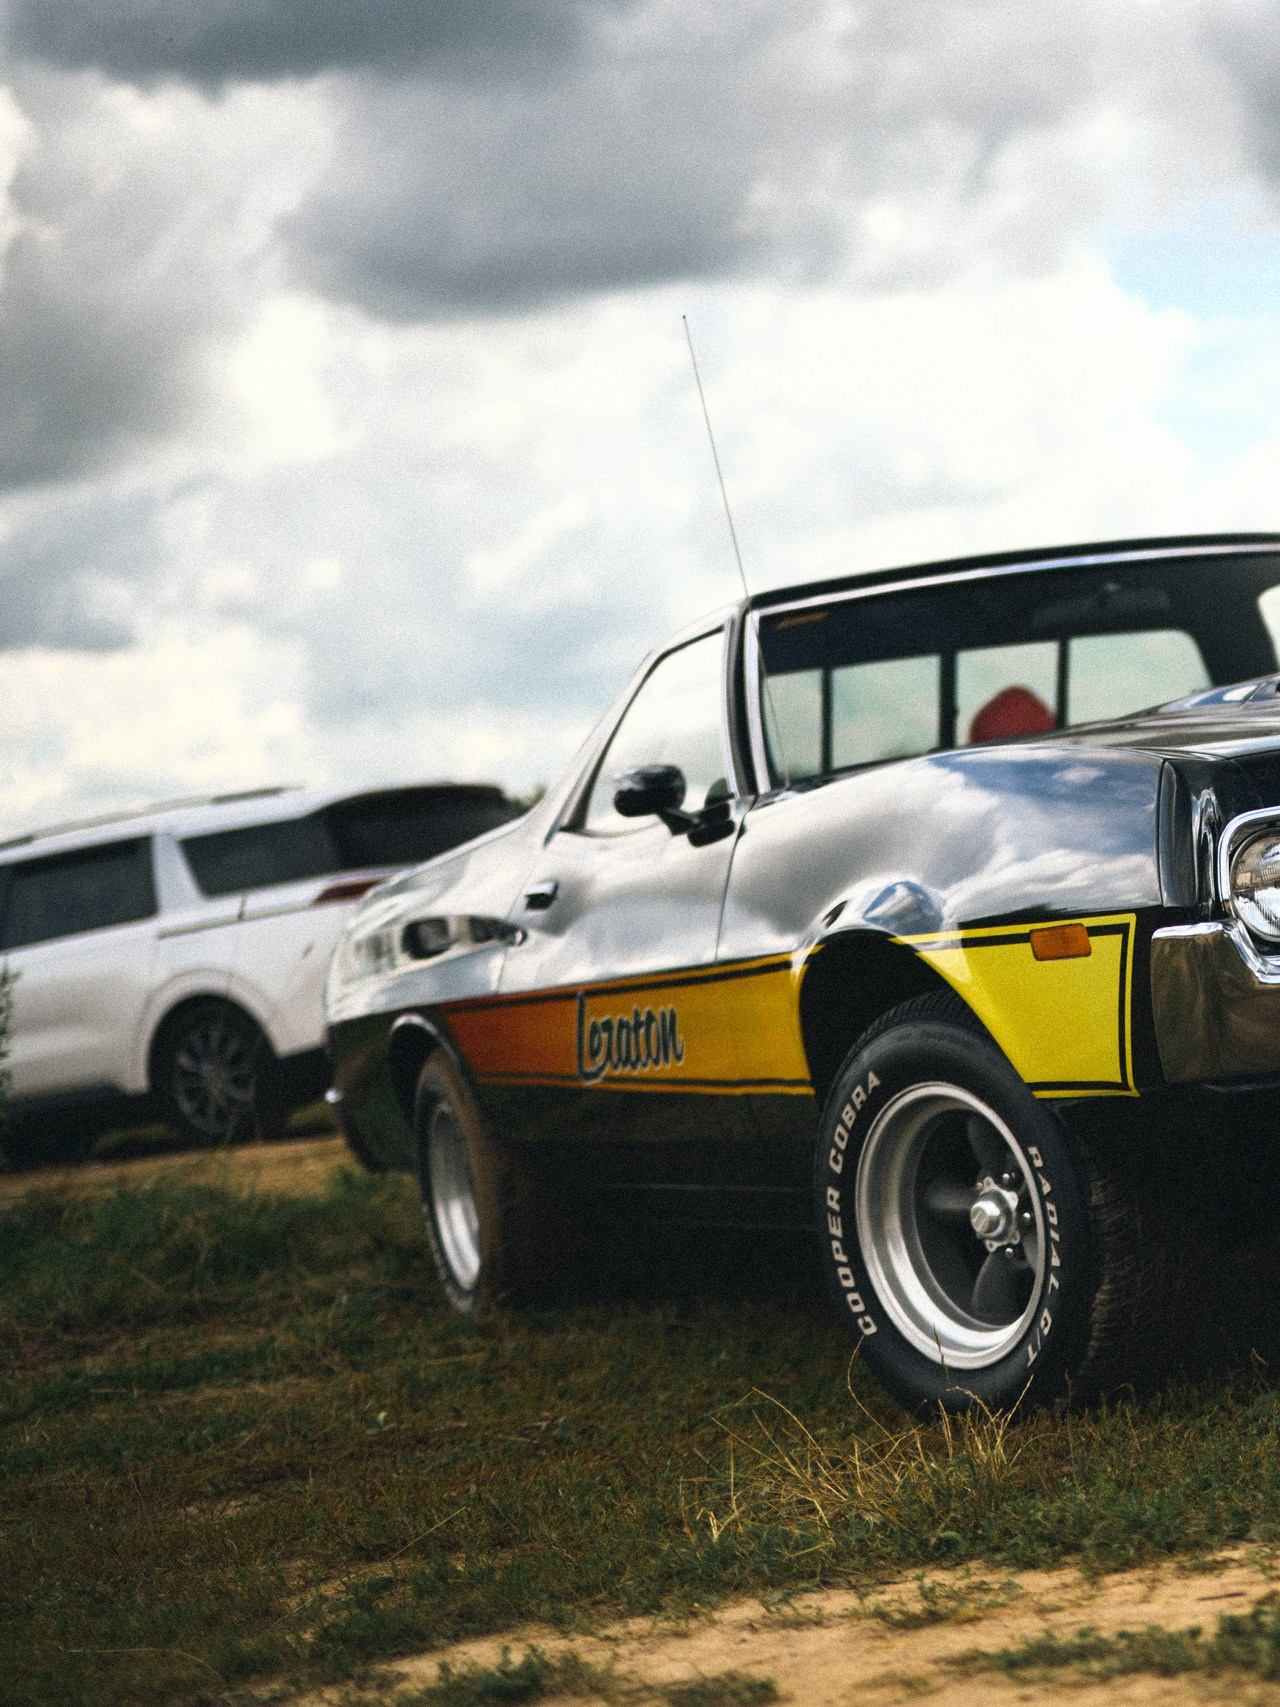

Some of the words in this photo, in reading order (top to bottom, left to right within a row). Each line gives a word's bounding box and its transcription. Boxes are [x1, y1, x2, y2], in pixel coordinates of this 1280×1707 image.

[828, 1070, 882, 1175] COBRA
[826, 1186, 879, 1336] COOPER
[1027, 1146, 1062, 1295] RADIAL
